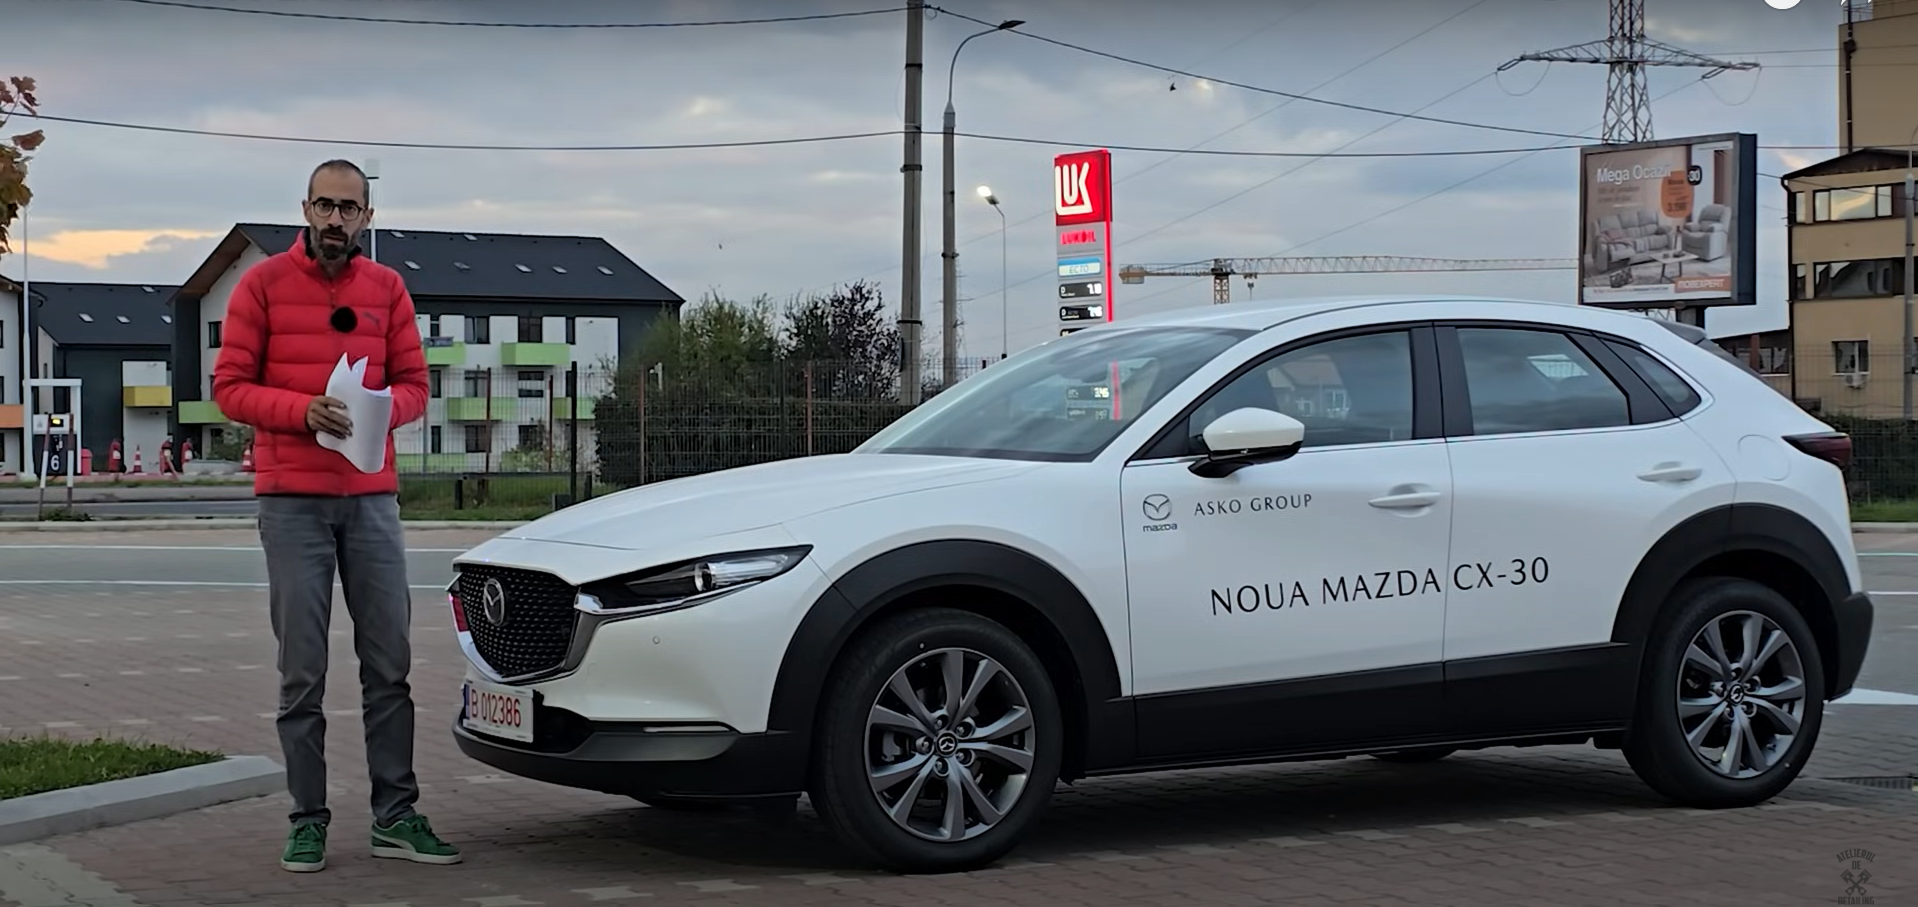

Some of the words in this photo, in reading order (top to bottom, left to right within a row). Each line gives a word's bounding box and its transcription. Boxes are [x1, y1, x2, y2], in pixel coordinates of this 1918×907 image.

[1597, 168, 1630, 185] Mega
[50, 454, 60, 471] 6
[1194, 499, 1242, 517] ASKO
[1250, 493, 1312, 512] GROUP
[1210, 580, 1310, 616] NOUA
[1322, 567, 1441, 605] MAZDA
[1453, 556, 1550, 592] CX-30
[471, 688, 479, 718] B
[481, 692, 521, 728] 012386
